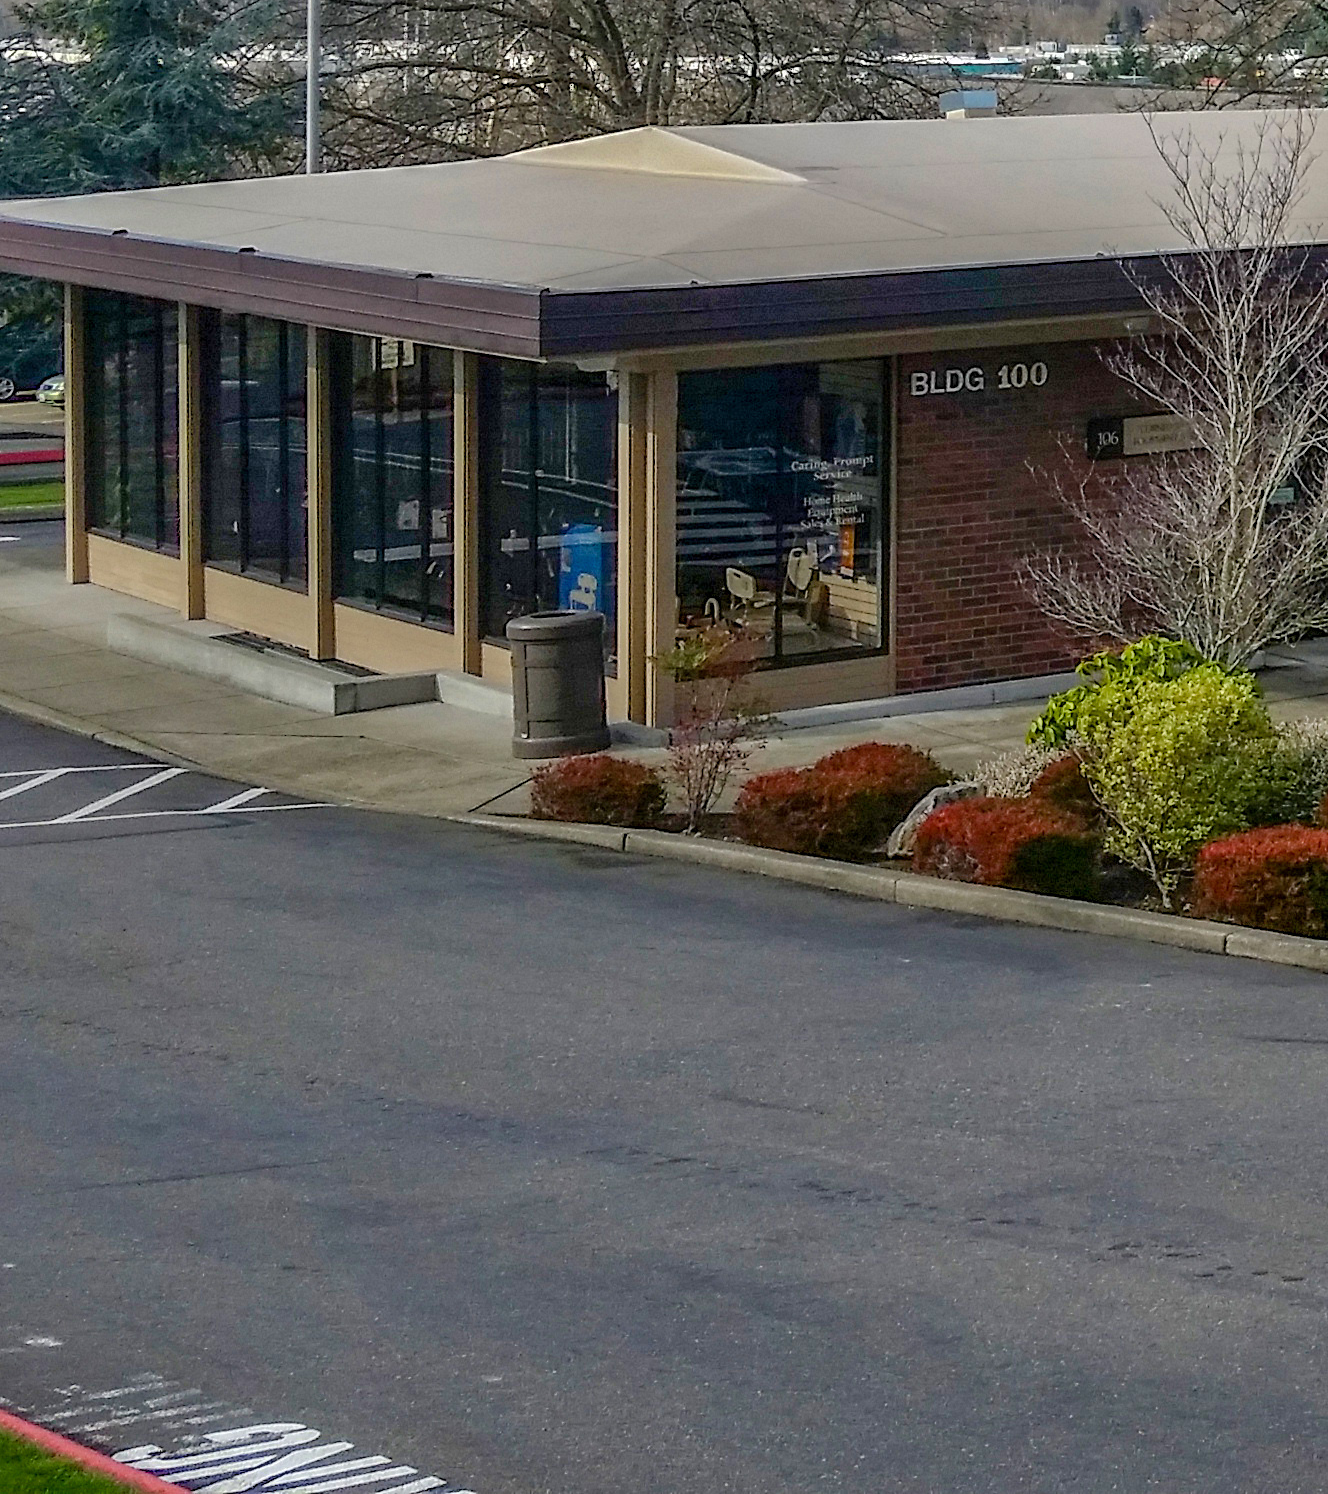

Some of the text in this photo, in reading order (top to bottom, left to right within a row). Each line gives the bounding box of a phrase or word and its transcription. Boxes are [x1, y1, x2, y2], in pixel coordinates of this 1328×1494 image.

[911, 362, 1048, 396] BLDG 100
[1098, 431, 1119, 446] 106
[833, 455, 874, 467] Prompt
[814, 470, 852, 480] Service
[804, 497, 831, 506] Home
